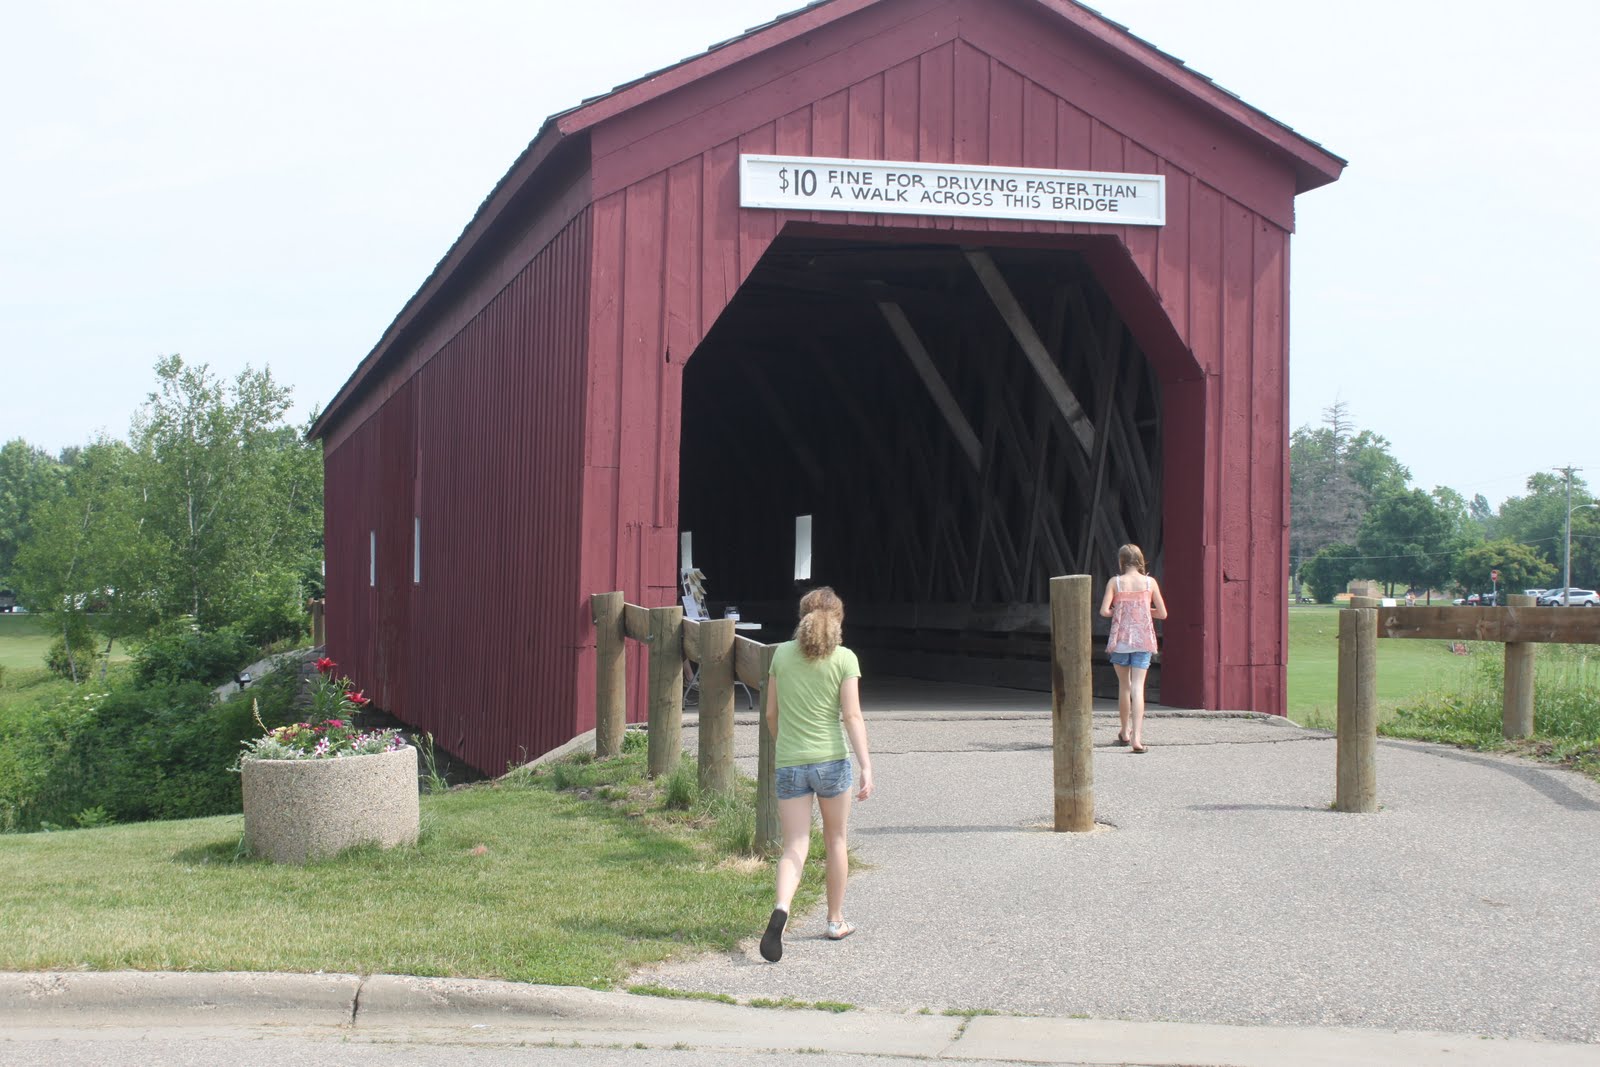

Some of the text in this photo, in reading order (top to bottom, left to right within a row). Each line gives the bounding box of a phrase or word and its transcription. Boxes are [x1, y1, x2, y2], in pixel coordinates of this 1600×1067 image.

[779, 167, 1137, 198] $10 FINE FOR DRIVING FASTER THAN
[830, 186, 1118, 212] A WALK ACROSS THIS BRIDGE
